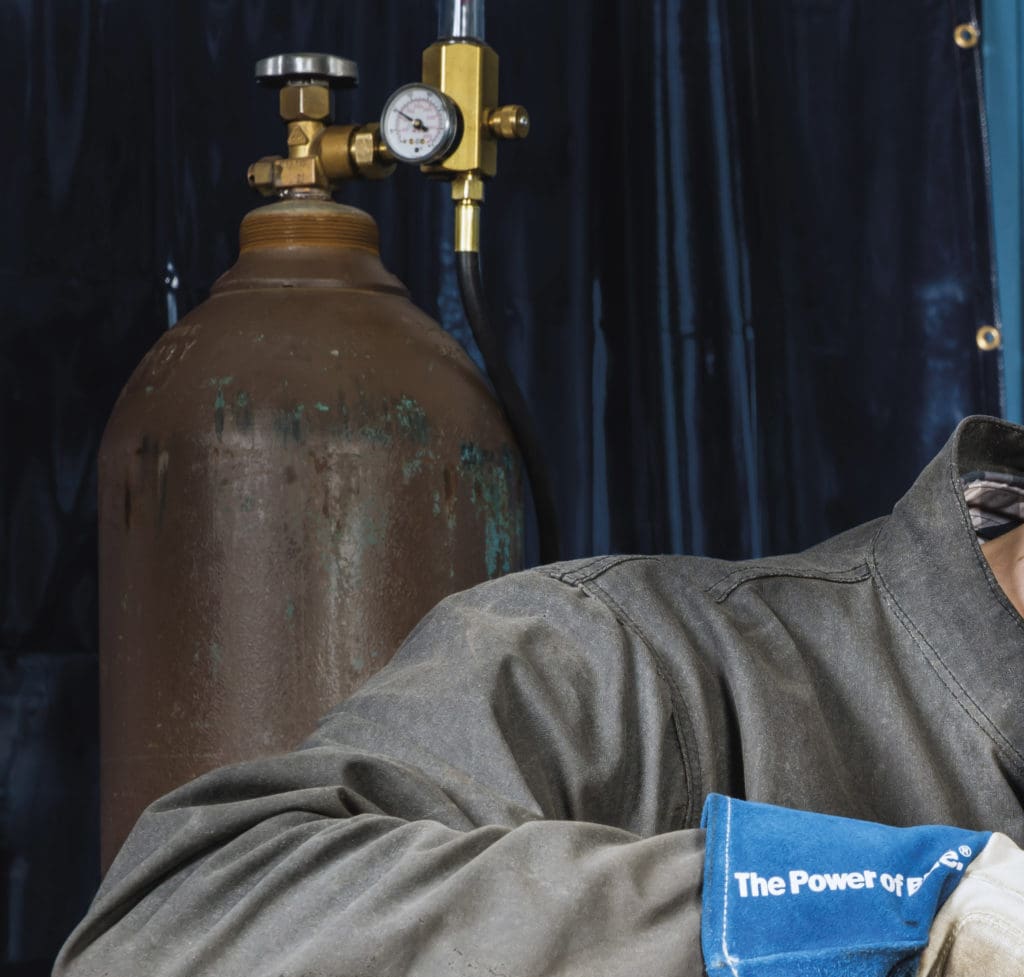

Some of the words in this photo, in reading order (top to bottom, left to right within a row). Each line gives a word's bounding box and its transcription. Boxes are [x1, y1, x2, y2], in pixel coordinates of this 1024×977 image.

[734, 872, 786, 898] The
[788, 870, 877, 895] Power
[880, 873, 904, 897] of
